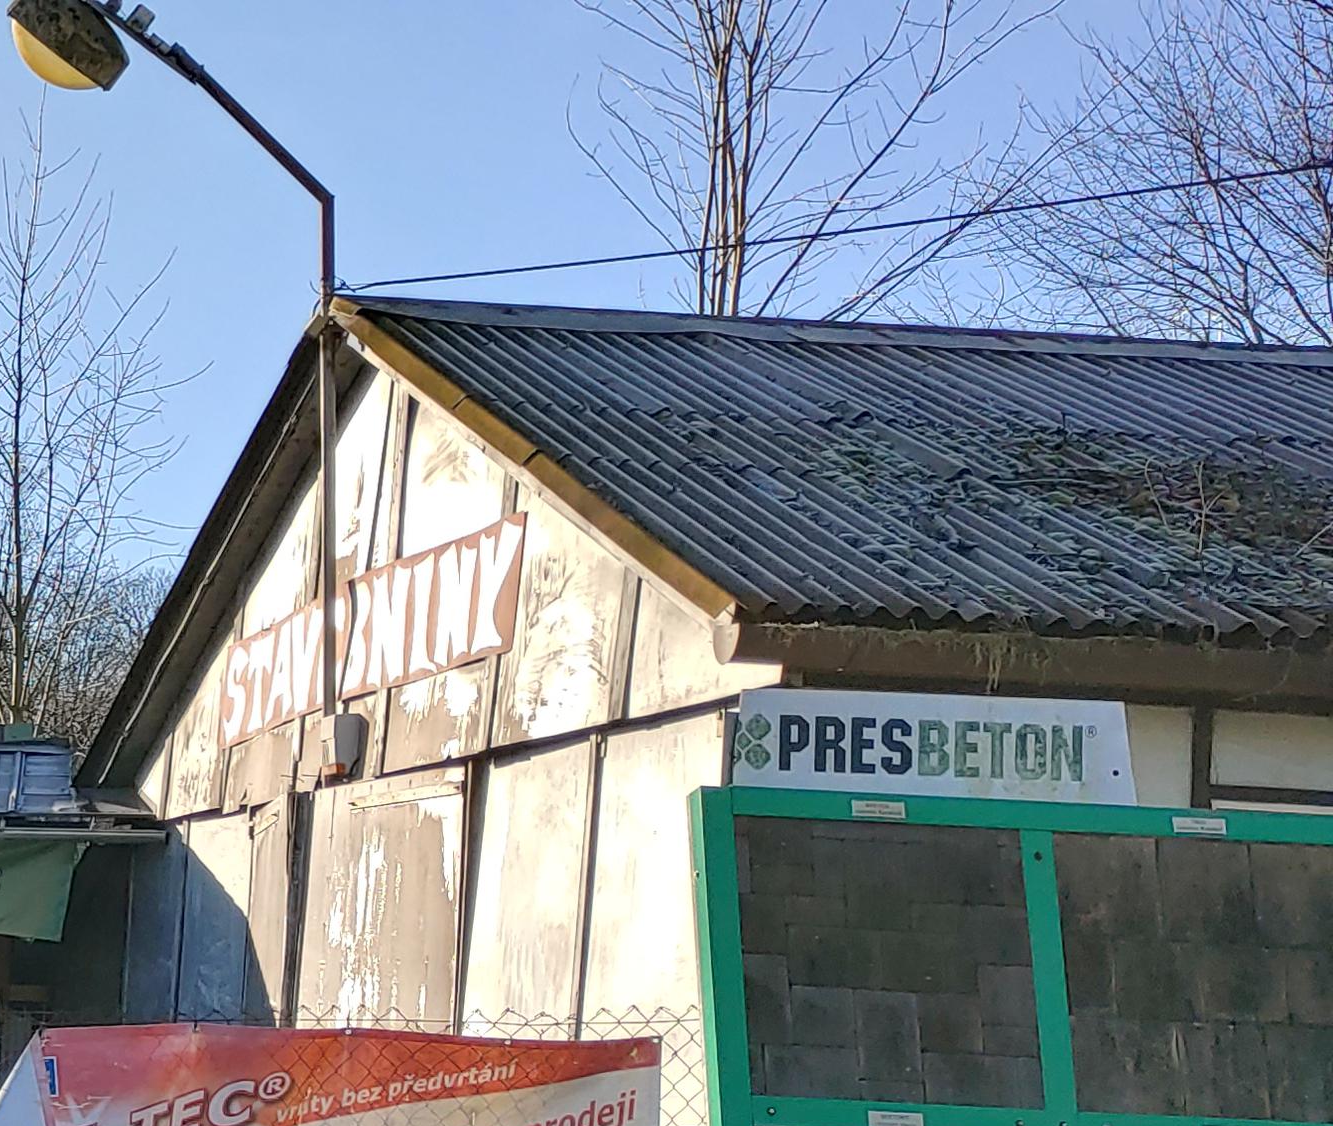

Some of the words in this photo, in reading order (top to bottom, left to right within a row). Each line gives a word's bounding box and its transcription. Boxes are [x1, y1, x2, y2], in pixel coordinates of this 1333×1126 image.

[275, 1094, 332, 1124] vruty
[342, 1087, 383, 1109] bez
[388, 1059, 517, 1103] předvrtání
